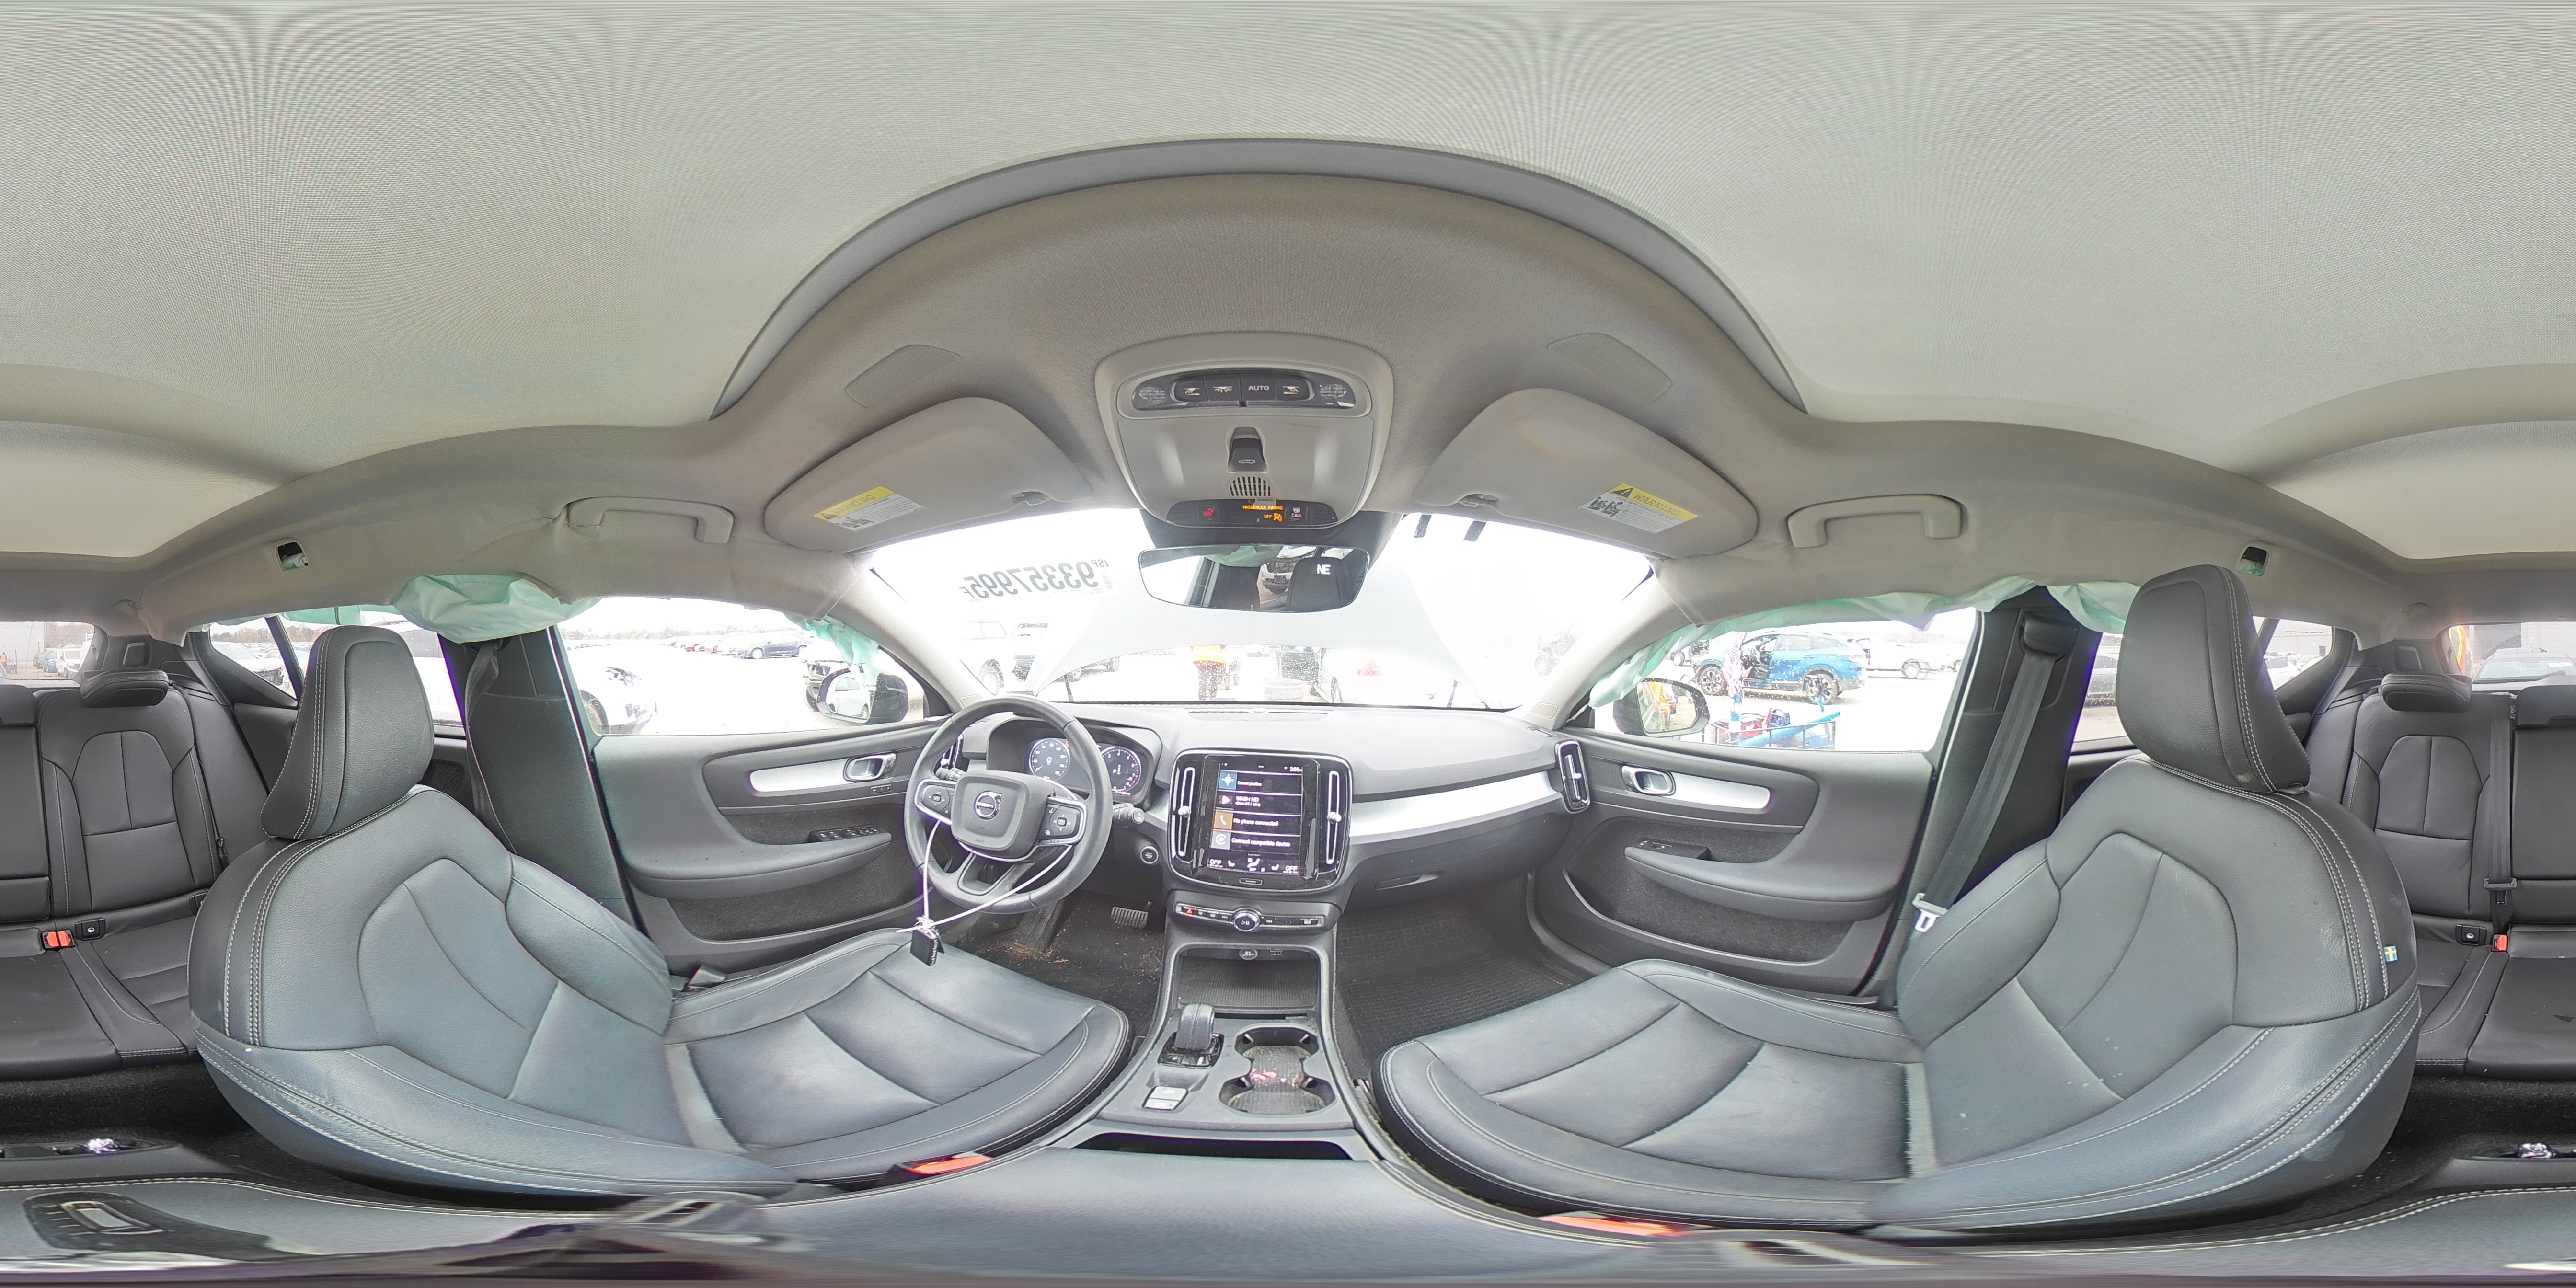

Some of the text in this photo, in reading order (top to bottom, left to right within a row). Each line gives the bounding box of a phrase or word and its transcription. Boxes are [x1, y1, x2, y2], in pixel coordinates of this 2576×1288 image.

[831, 494, 876, 515] WARNING
[1633, 494, 1680, 516] WARNING
[1317, 564, 1331, 575] NE
